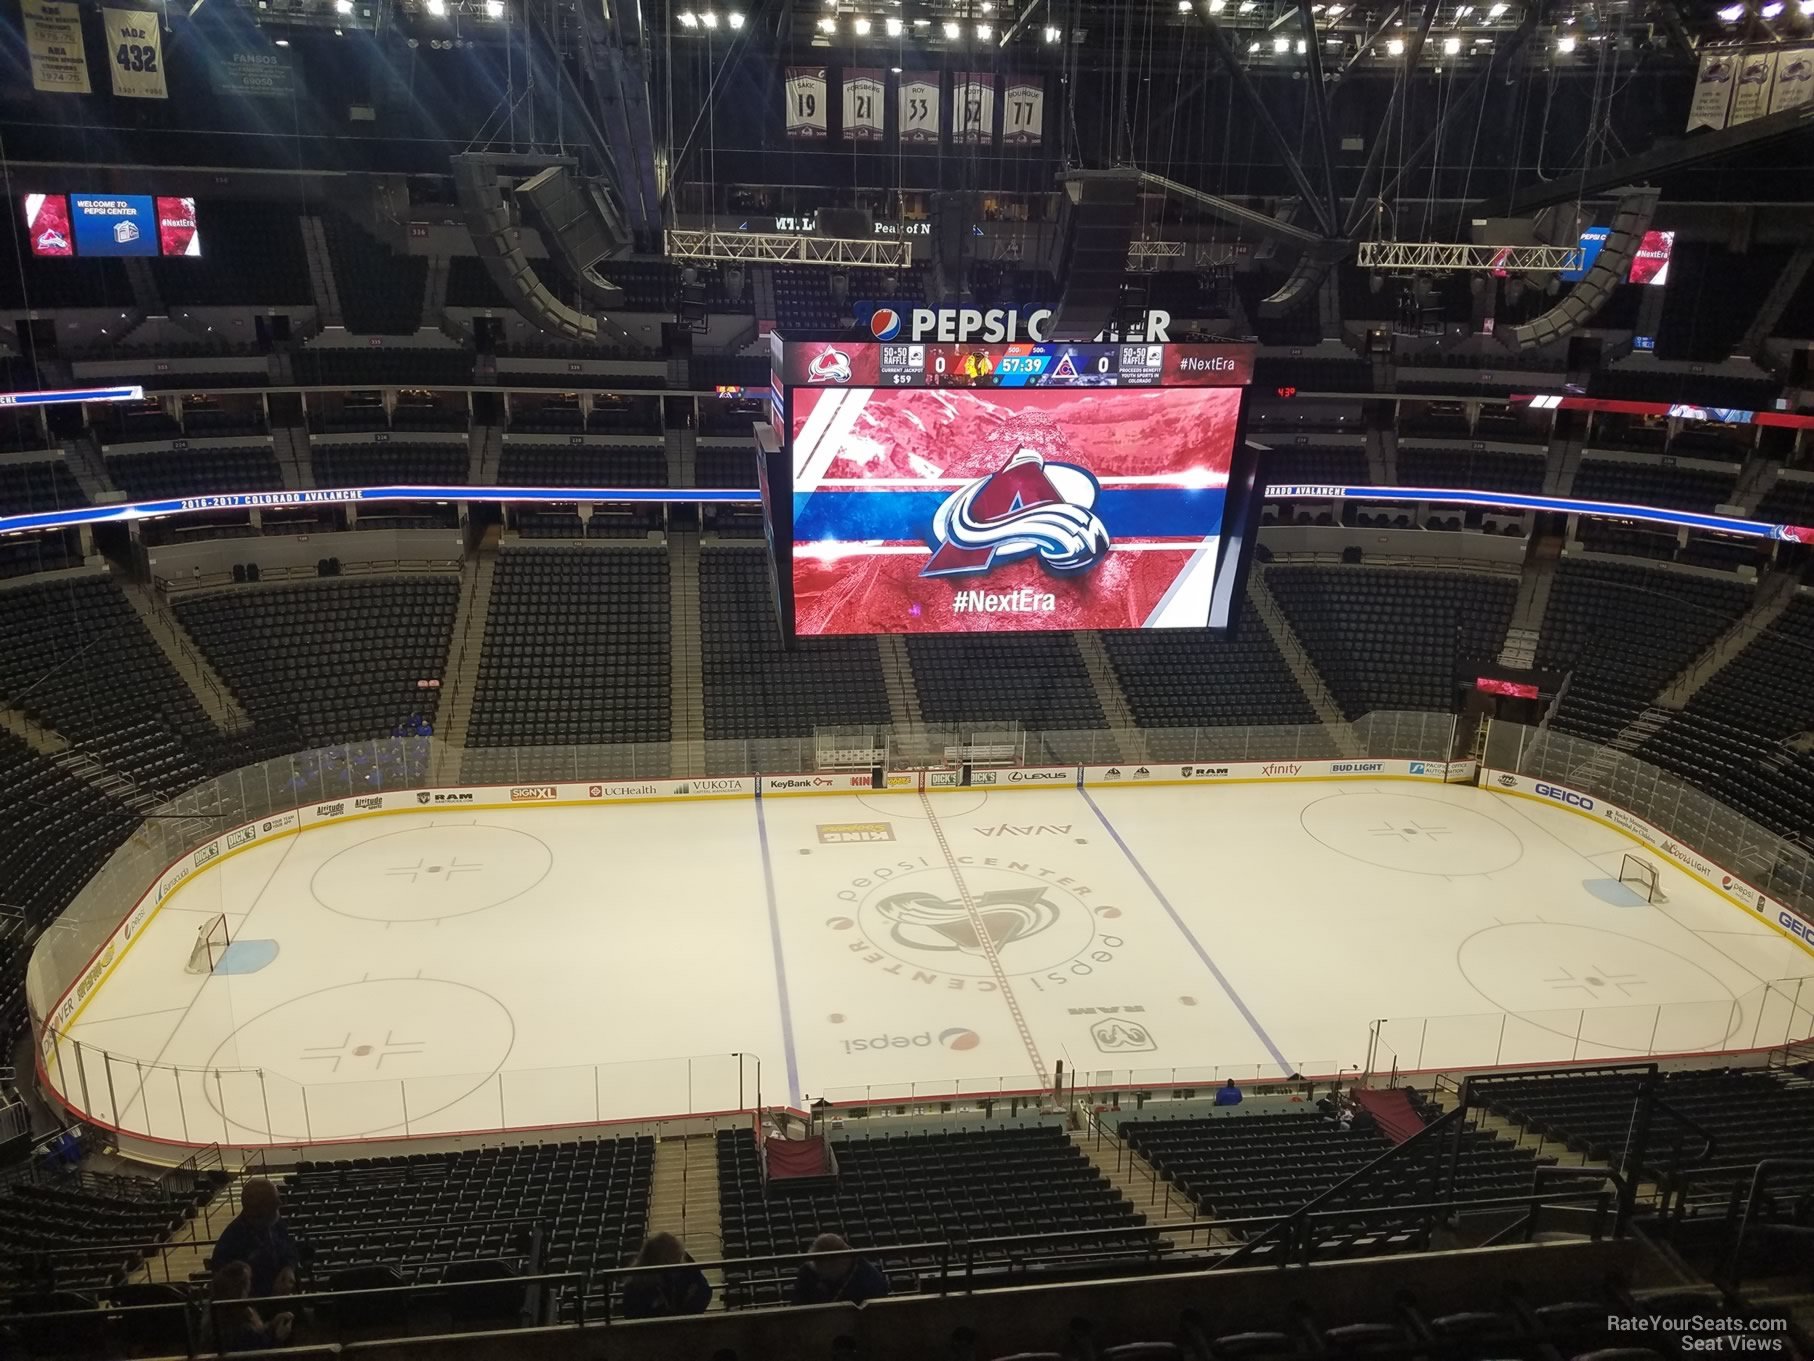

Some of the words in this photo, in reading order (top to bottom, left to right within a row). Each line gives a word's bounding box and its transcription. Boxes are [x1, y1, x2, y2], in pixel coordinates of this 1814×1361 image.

[117, 44, 157, 72] 432
[847, 83, 880, 93] FORSBERG
[798, 94, 815, 117] 19
[857, 96, 871, 119] 21
[909, 99, 928, 121] 33
[1014, 102, 1033, 125] 77
[162, 219, 194, 227] #NextEra
[906, 223, 918, 234] of
[912, 309, 1016, 342] PEPSI
[884, 356, 907, 365] RAFFLE
[935, 357, 945, 373] 0
[1002, 358, 1042, 372] 57:39
[1098, 357, 1108, 373] 0
[1123, 356, 1145, 365] RAFFLE
[1180, 357, 1235, 371] #NextEra
[893, 374, 912, 384] $59
[181, 496, 239, 510] 2016-2017
[245, 493, 300, 504] COLORADO
[305, 490, 363, 501] AVALANCHE
[1295, 487, 1346, 497] AVALANCHE
[953, 589, 1055, 613] #NextEra
[1262, 763, 1302, 776] xfinity
[1332, 764, 1353, 772] BUD
[1354, 763, 1383, 772] LIGHT
[771, 779, 811, 789] KeyBank
[852, 776, 873, 786] KIN
[933, 774, 957, 783] DICK'S
[971, 772, 996, 782] DICK'S
[1024, 772, 1067, 780] LEXUS
[605, 785, 657, 796] UCHealth
[693, 780, 742, 790] VUKOTA
[1535, 783, 1594, 811] GEICO
[229, 826, 255, 847] DICK'S
[824, 832, 890, 842] KING
[973, 824, 1072, 836] AVAYA
[196, 843, 218, 864] DICK'S
[1691, 859, 1712, 878] LIGHT
[163, 867, 190, 894] Barracuda
[837, 856, 929, 902] pepsi
[957, 856, 1092, 897] CENTER
[1733, 882, 1754, 899] pepsi
[131, 907, 146, 932] pepsi
[848, 940, 998, 993] CENTER
[1031, 934, 1124, 992] pepsi
[839, 1031, 932, 1055] pepsi
